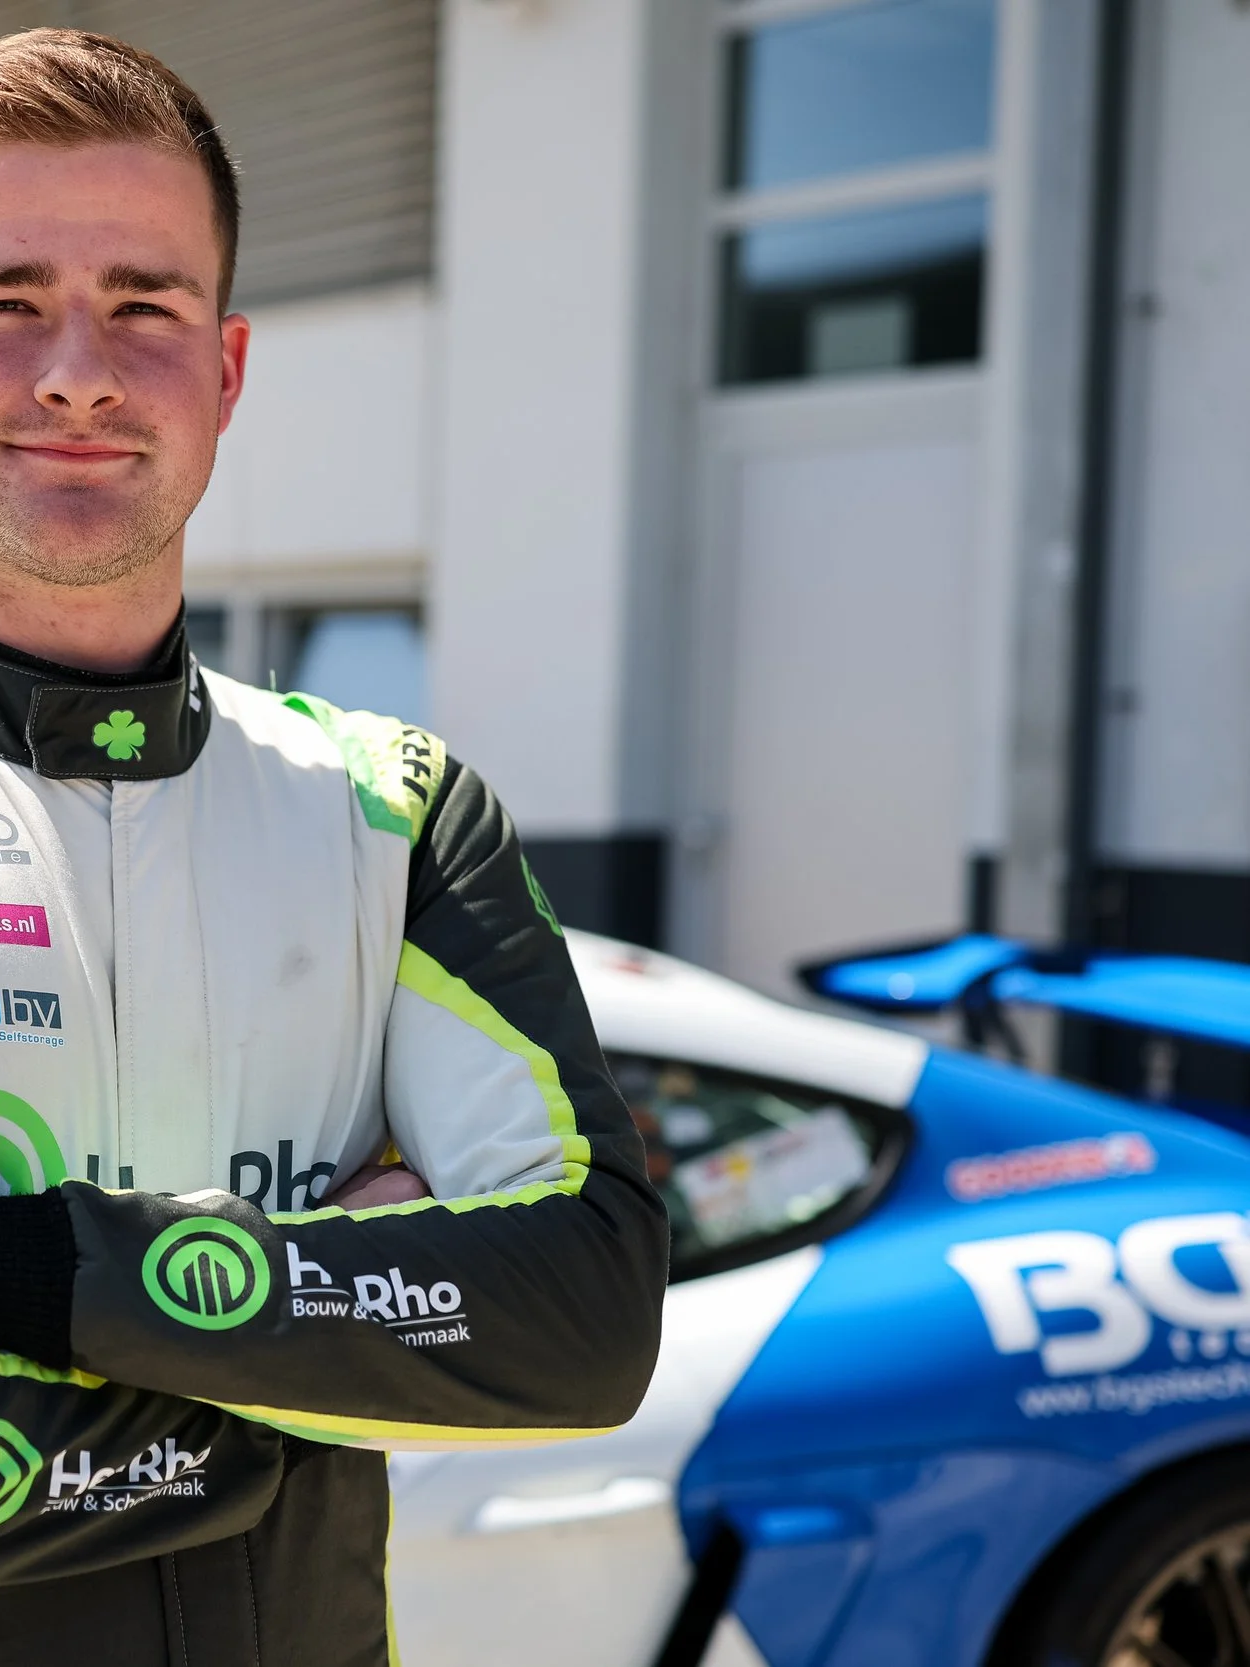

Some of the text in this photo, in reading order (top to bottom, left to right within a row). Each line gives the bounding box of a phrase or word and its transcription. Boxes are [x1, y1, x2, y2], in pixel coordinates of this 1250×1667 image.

[292, 1298, 349, 1317] Bouw
[353, 1300, 369, 1320] &
[84, 1494, 98, 1511] &
